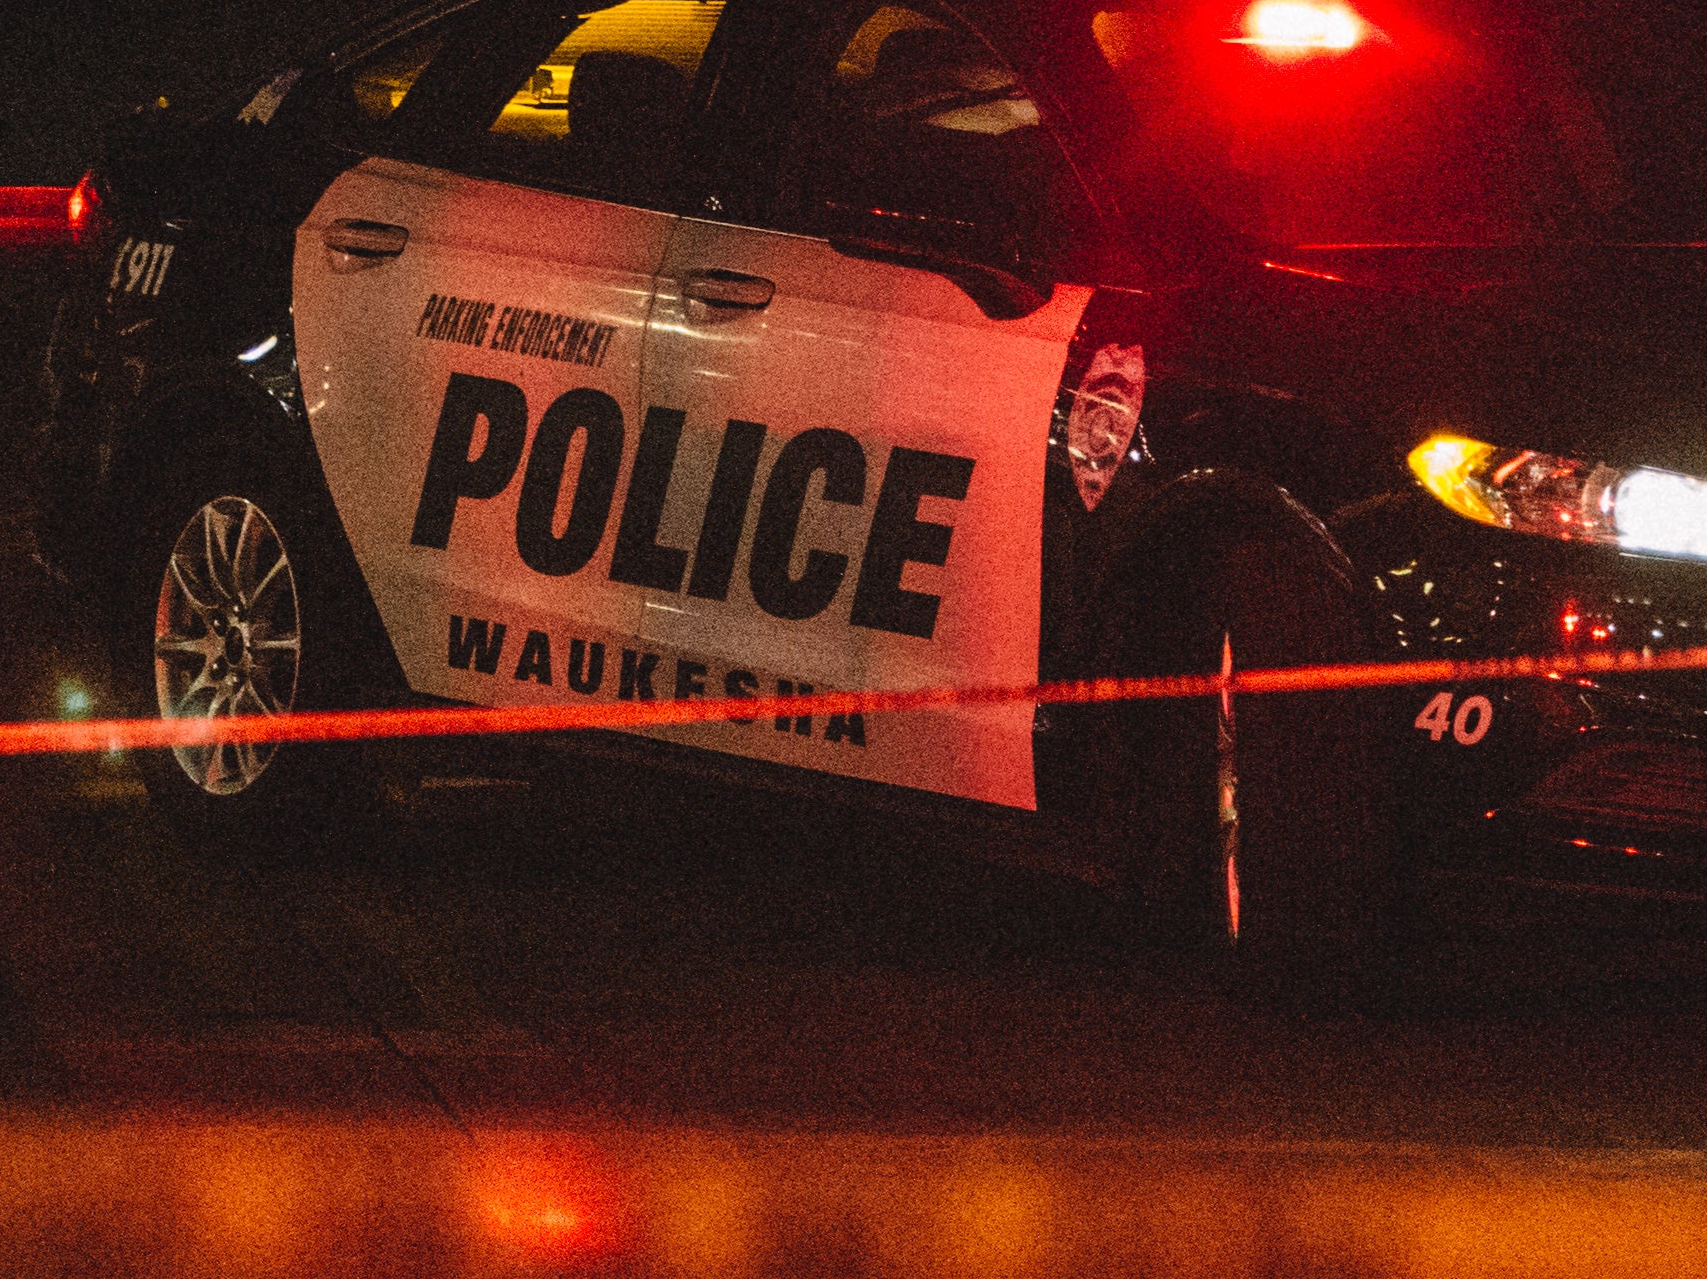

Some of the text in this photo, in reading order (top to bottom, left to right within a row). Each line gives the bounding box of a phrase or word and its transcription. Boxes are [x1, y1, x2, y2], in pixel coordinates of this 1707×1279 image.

[416, 293, 618, 367] PARKING ENFORCEMENT
[409, 371, 976, 640] POLICE
[1414, 691, 1493, 746] 40
